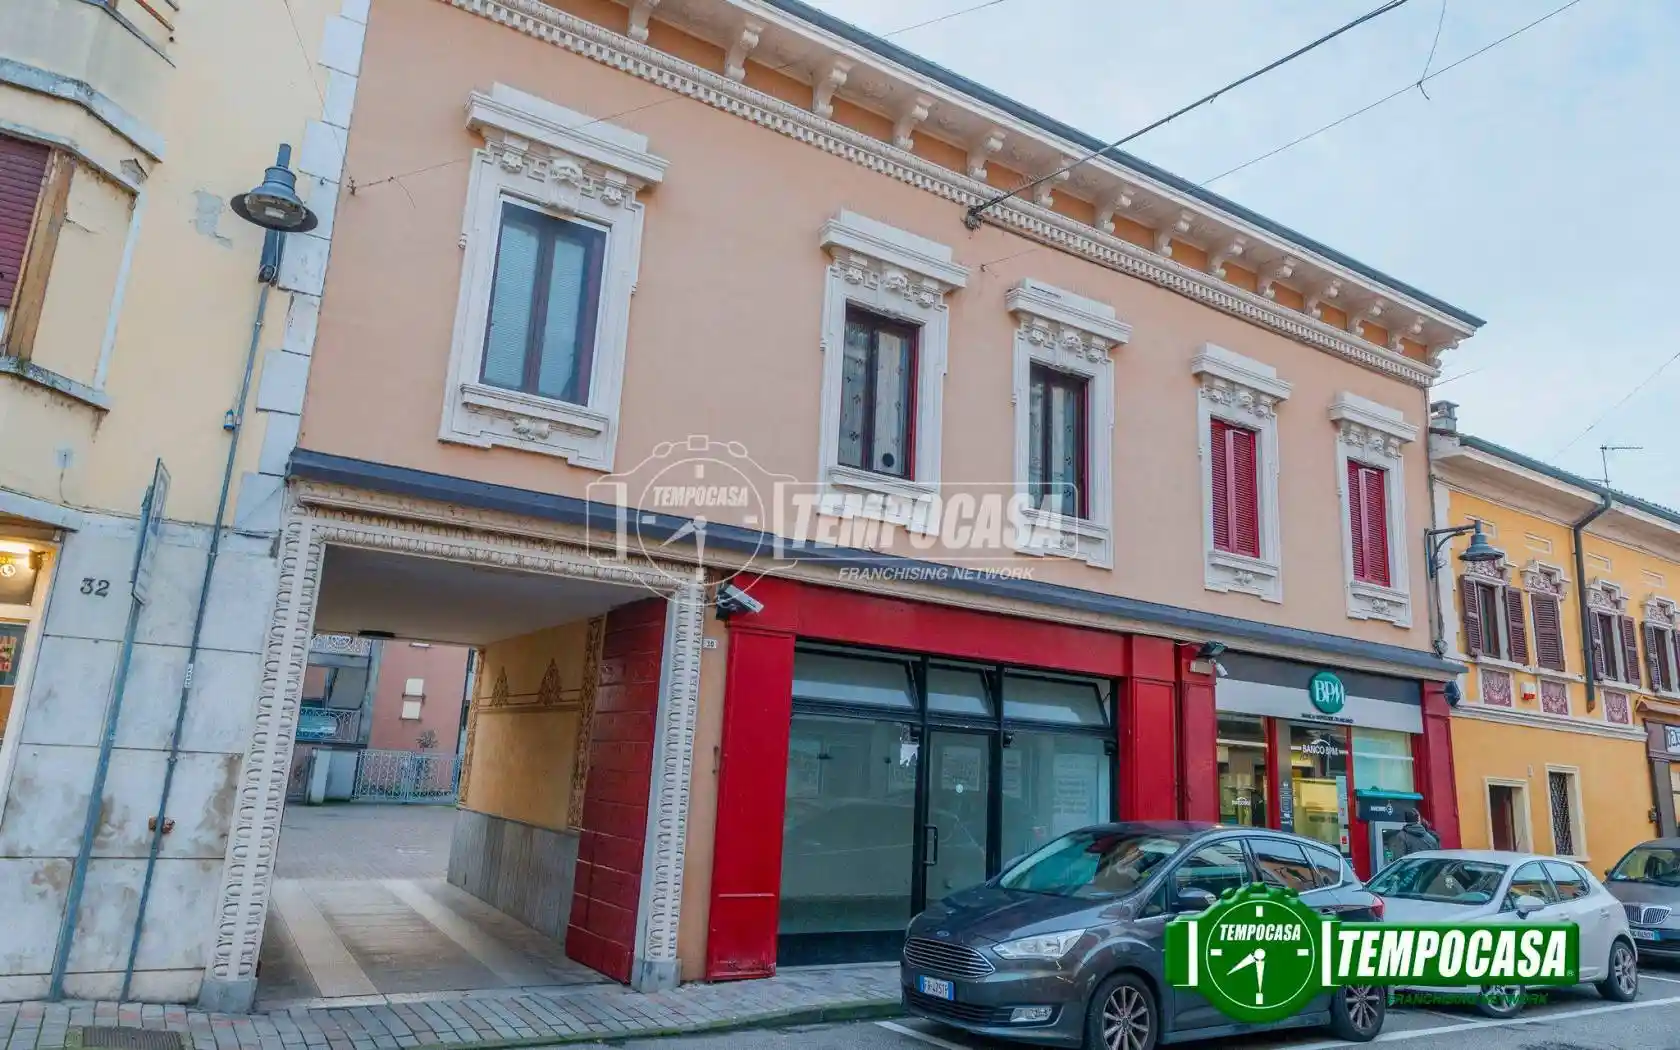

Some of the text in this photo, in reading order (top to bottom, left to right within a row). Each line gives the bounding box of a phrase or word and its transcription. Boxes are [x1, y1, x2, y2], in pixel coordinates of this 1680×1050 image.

[80, 578, 110, 597] 32
[1314, 679, 1345, 705] BPM
[1302, 744, 1325, 755] BANCO
